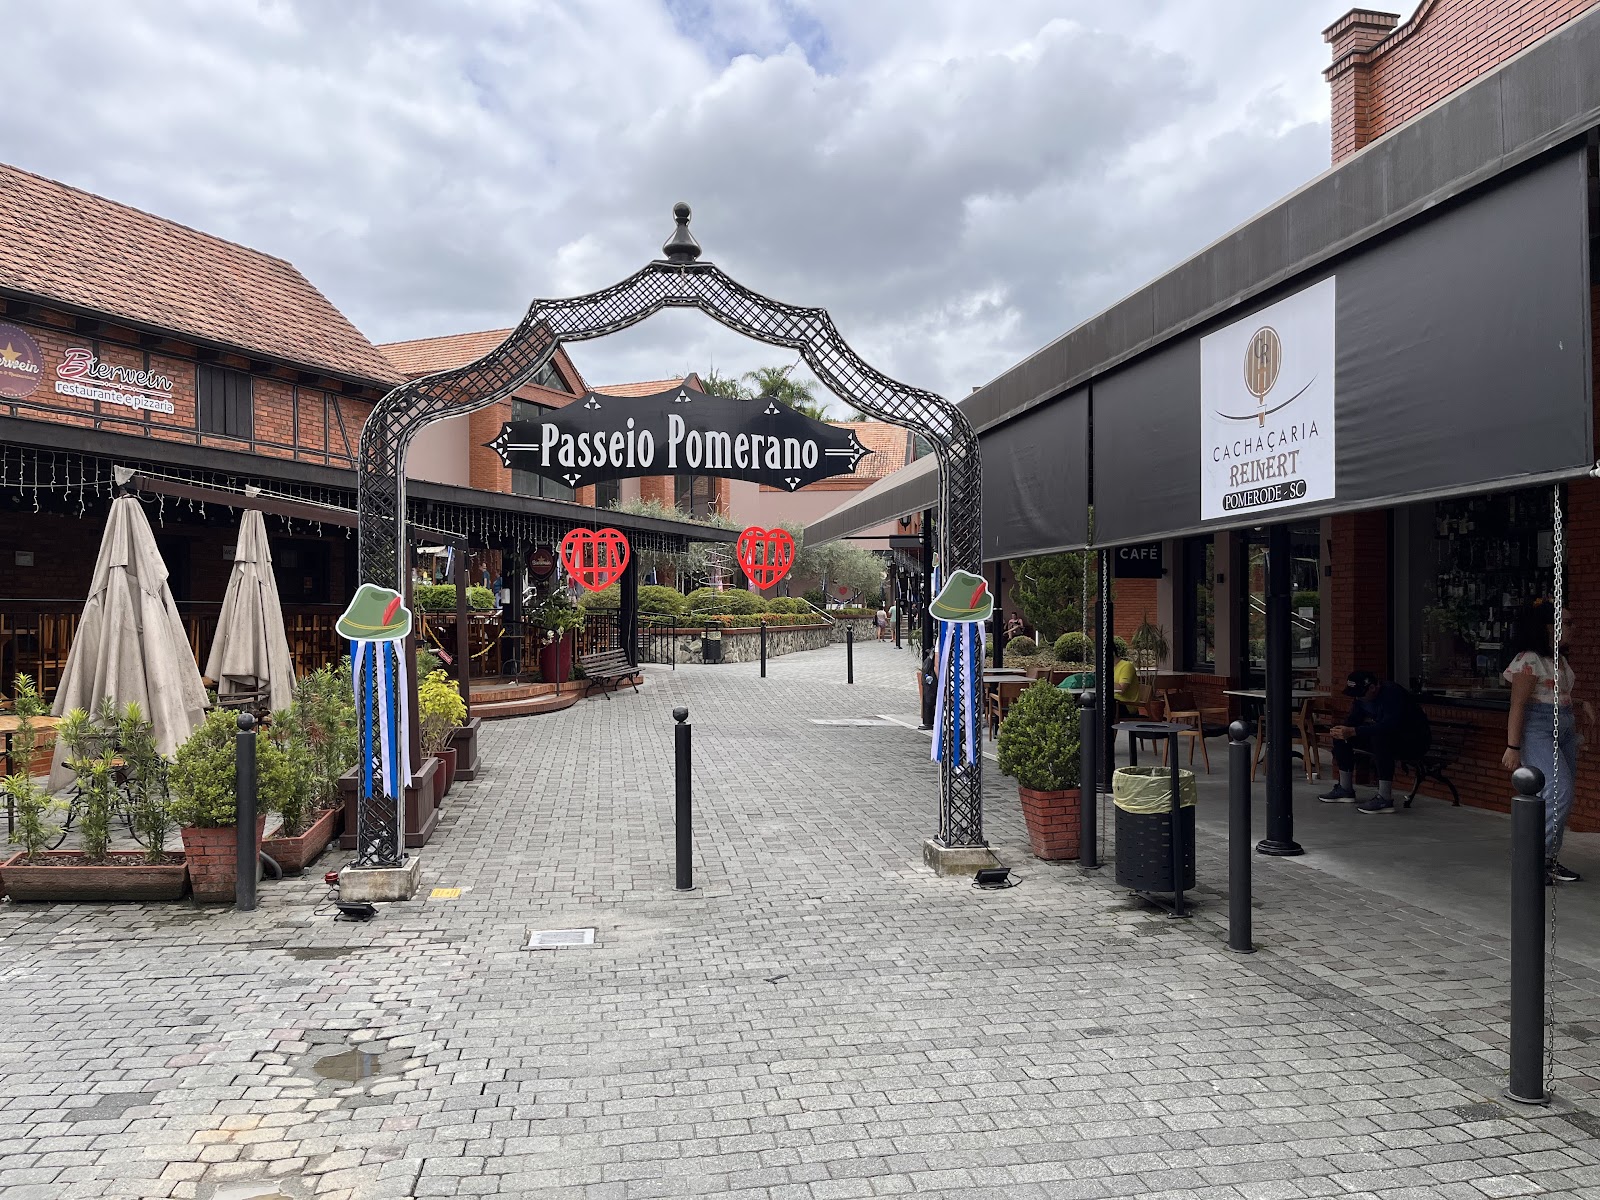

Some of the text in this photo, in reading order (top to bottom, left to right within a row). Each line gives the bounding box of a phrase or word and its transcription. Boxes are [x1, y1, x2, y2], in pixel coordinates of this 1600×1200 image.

[57, 348, 173, 391] Bierwein
[57, 382, 173, 412] restaurante e pizzaria
[541, 414, 819, 469] Passeio Pomerano
[1213, 420, 1319, 462] CACHAÇARIA
[1229, 449, 1300, 488] REINERT
[1224, 485, 1282, 510] POMERODE
[1289, 481, 1304, 498] SC
[1120, 545, 1158, 560] CAFÉ
